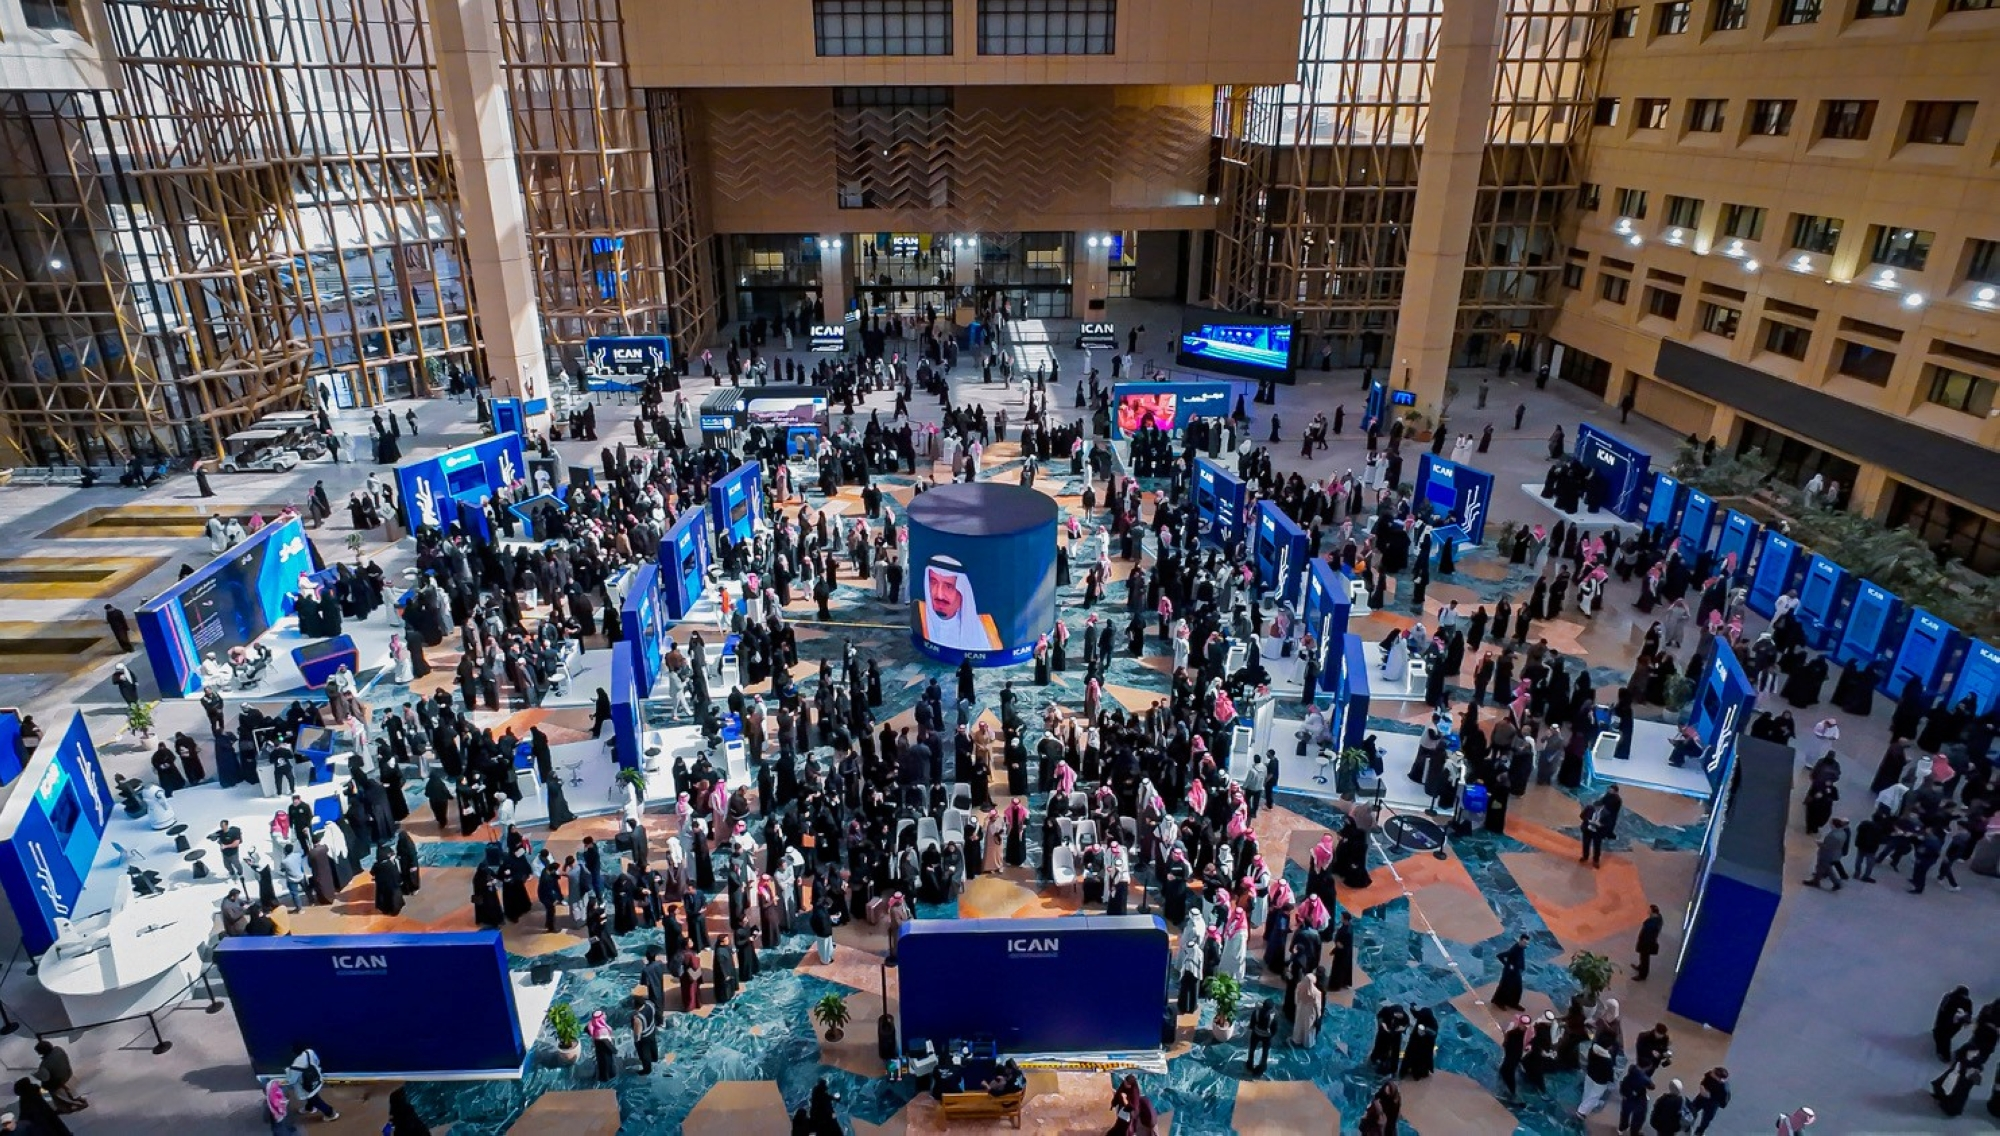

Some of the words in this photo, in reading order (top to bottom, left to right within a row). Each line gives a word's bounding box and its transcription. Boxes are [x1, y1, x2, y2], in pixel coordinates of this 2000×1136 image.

[893, 237, 919, 245] ICAN
[810, 326, 844, 336] ICAN
[1081, 324, 1114, 334] ICAN
[613, 348, 643, 359] ICAN
[1597, 449, 1616, 466] ICAN
[1433, 464, 1453, 478] ICAN
[924, 641, 940, 652] ICAN
[1013, 646, 1032, 656] ICAN
[964, 652, 986, 660] ICAN
[1008, 938, 1059, 952] ICAN
[332, 955, 388, 969] ICAN
